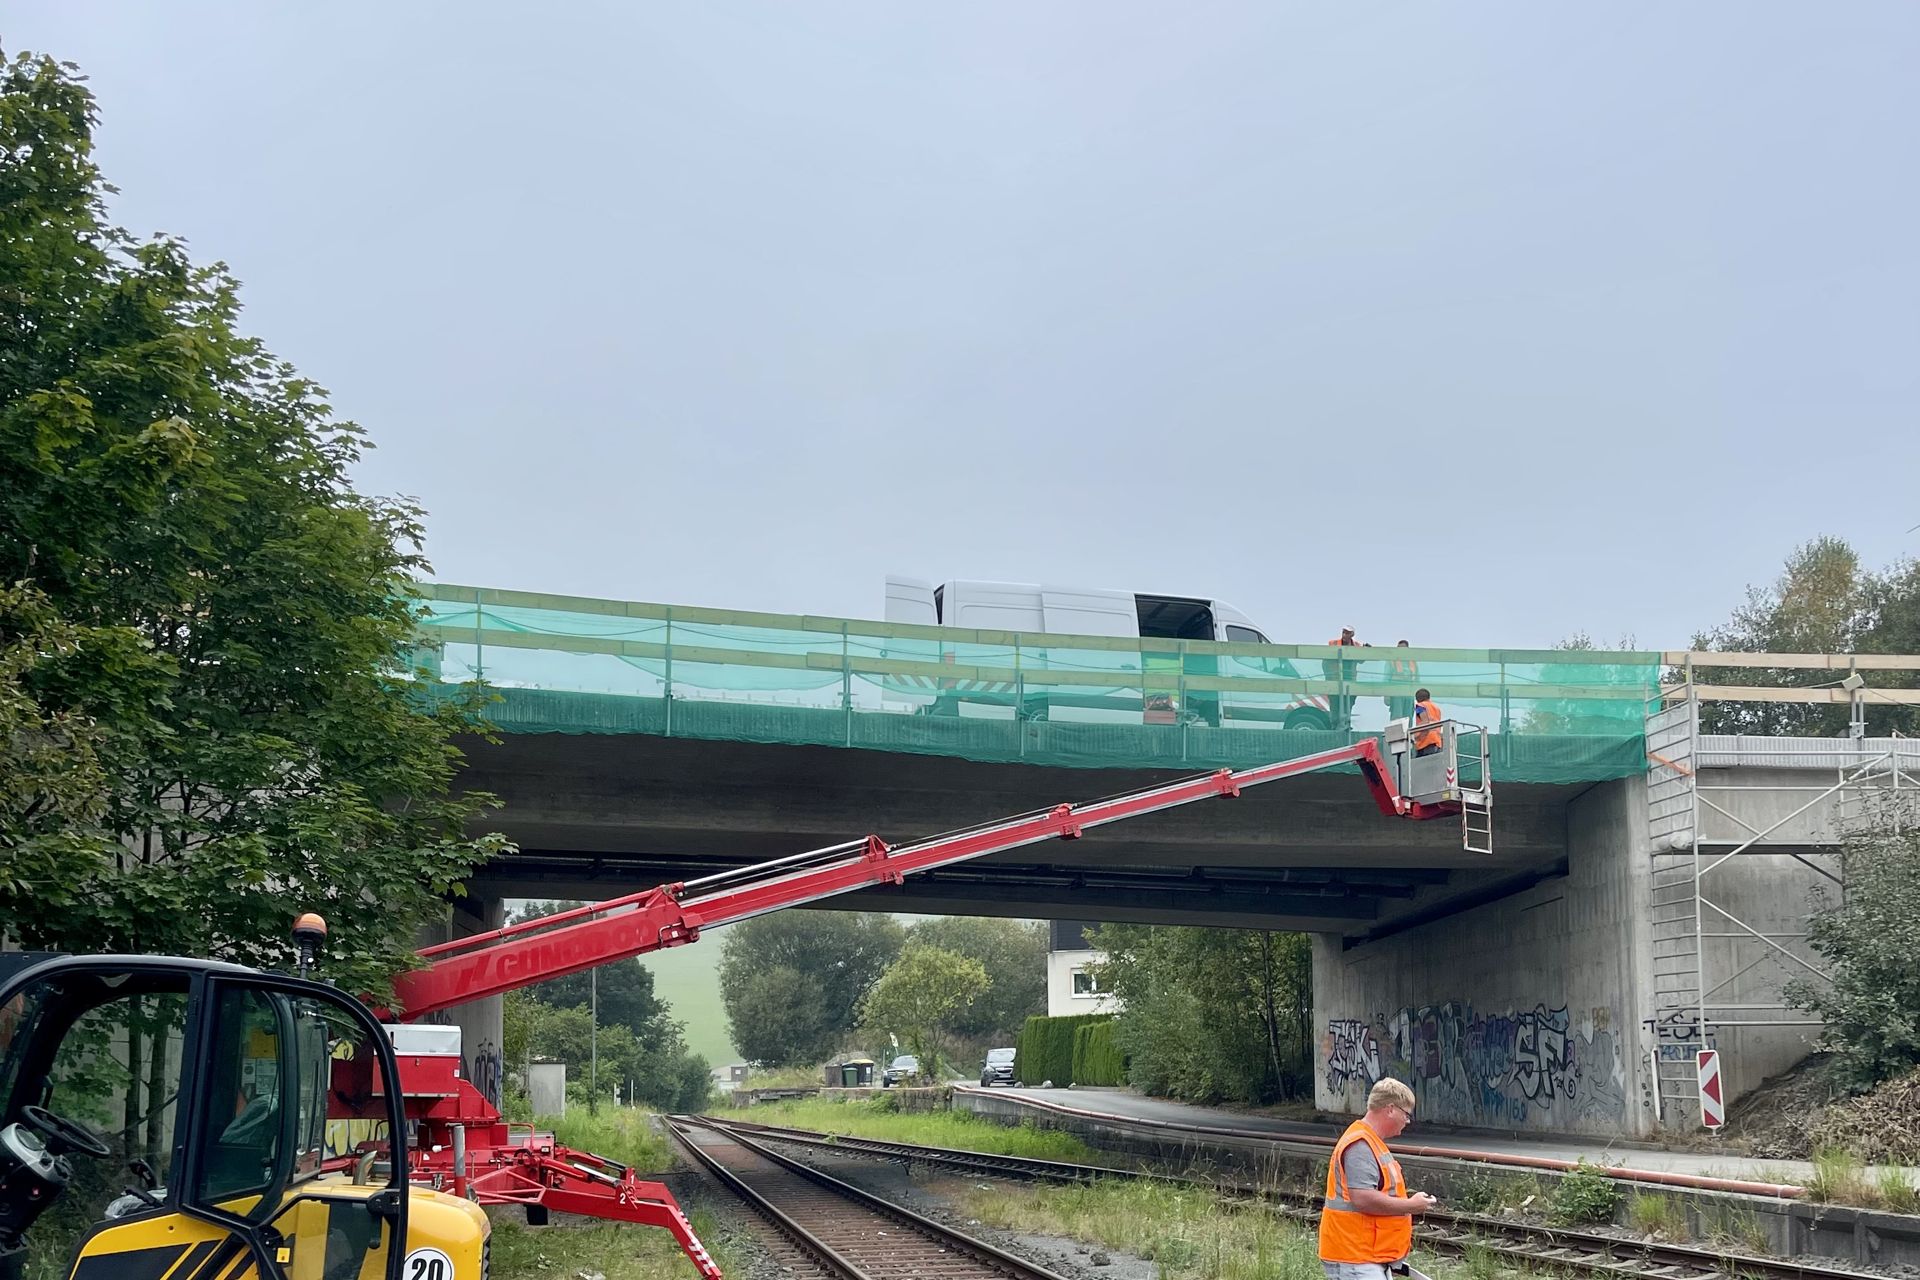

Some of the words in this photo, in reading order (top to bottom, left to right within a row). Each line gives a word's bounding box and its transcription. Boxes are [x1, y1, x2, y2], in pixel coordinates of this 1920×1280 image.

[630, 1175, 635, 1185] 1
[619, 1193, 626, 1204] 2
[411, 1258, 444, 1280] 20
